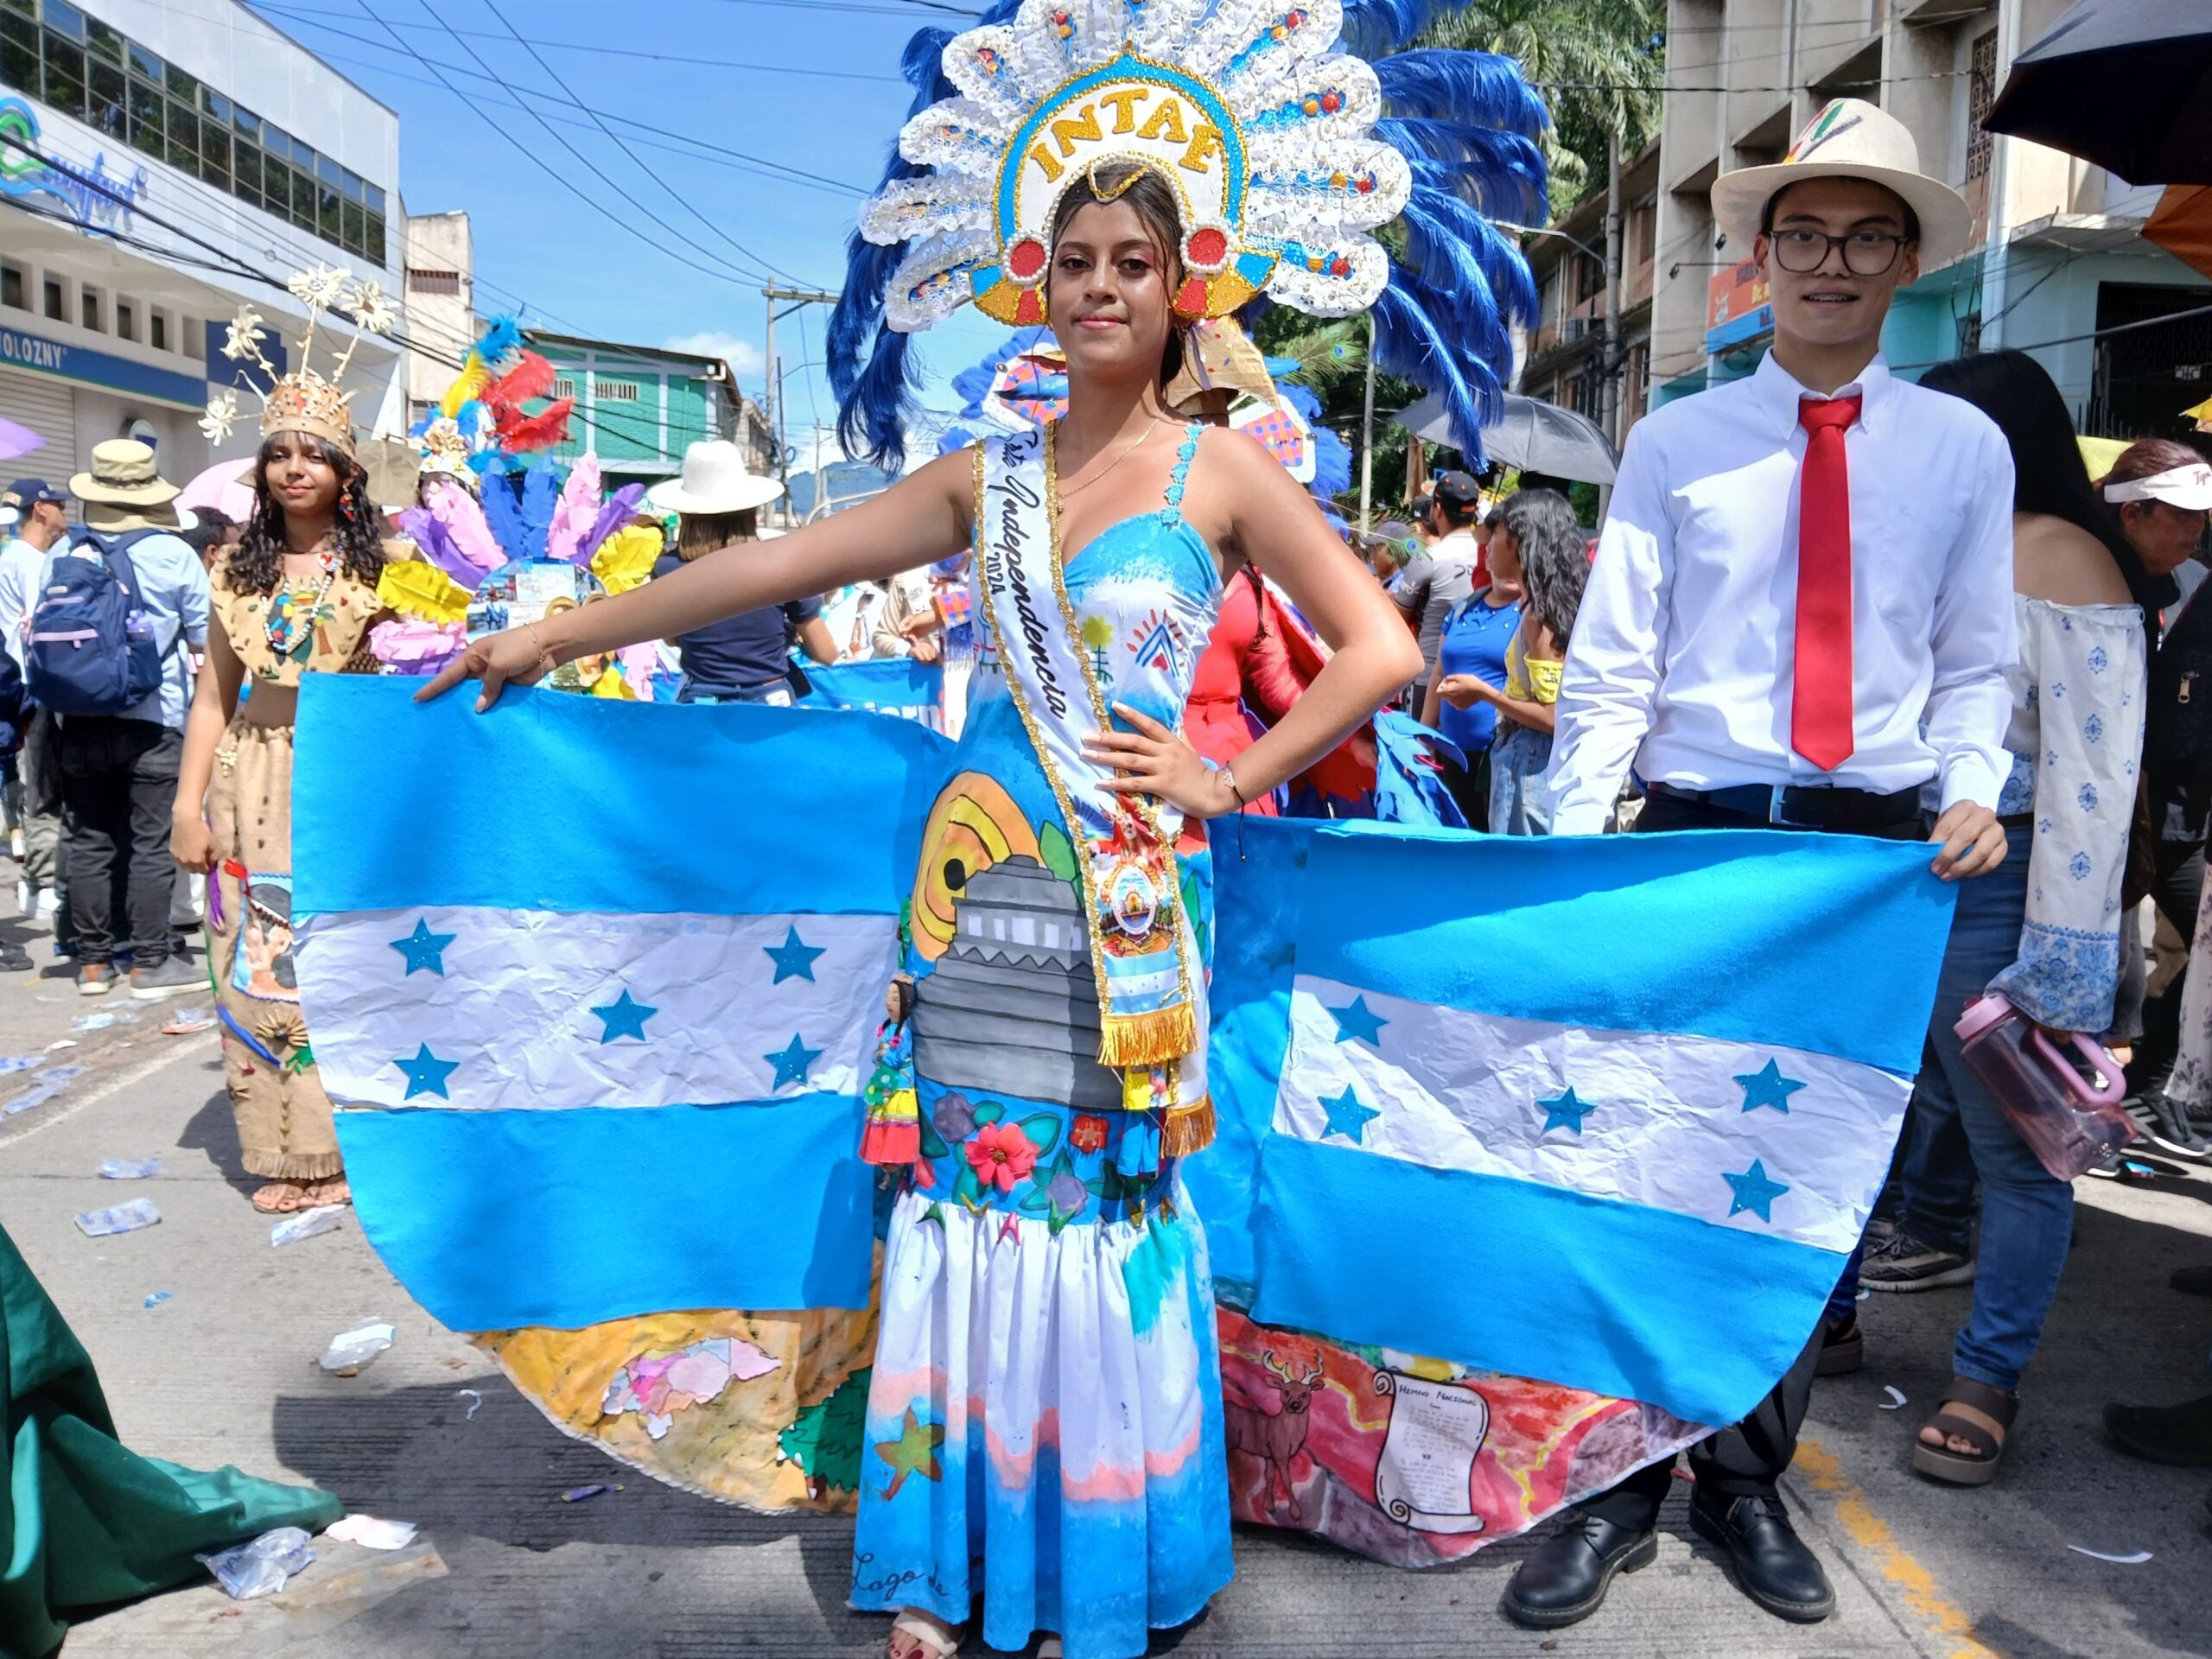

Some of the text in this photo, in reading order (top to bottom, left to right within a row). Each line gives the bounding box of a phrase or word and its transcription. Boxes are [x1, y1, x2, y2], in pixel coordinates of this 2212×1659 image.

[0, 331, 61, 369] OLOZNY
[986, 551, 1007, 595] 2024
[987, 475, 1067, 720] Independencia
[851, 1552, 950, 1601] Lago de
